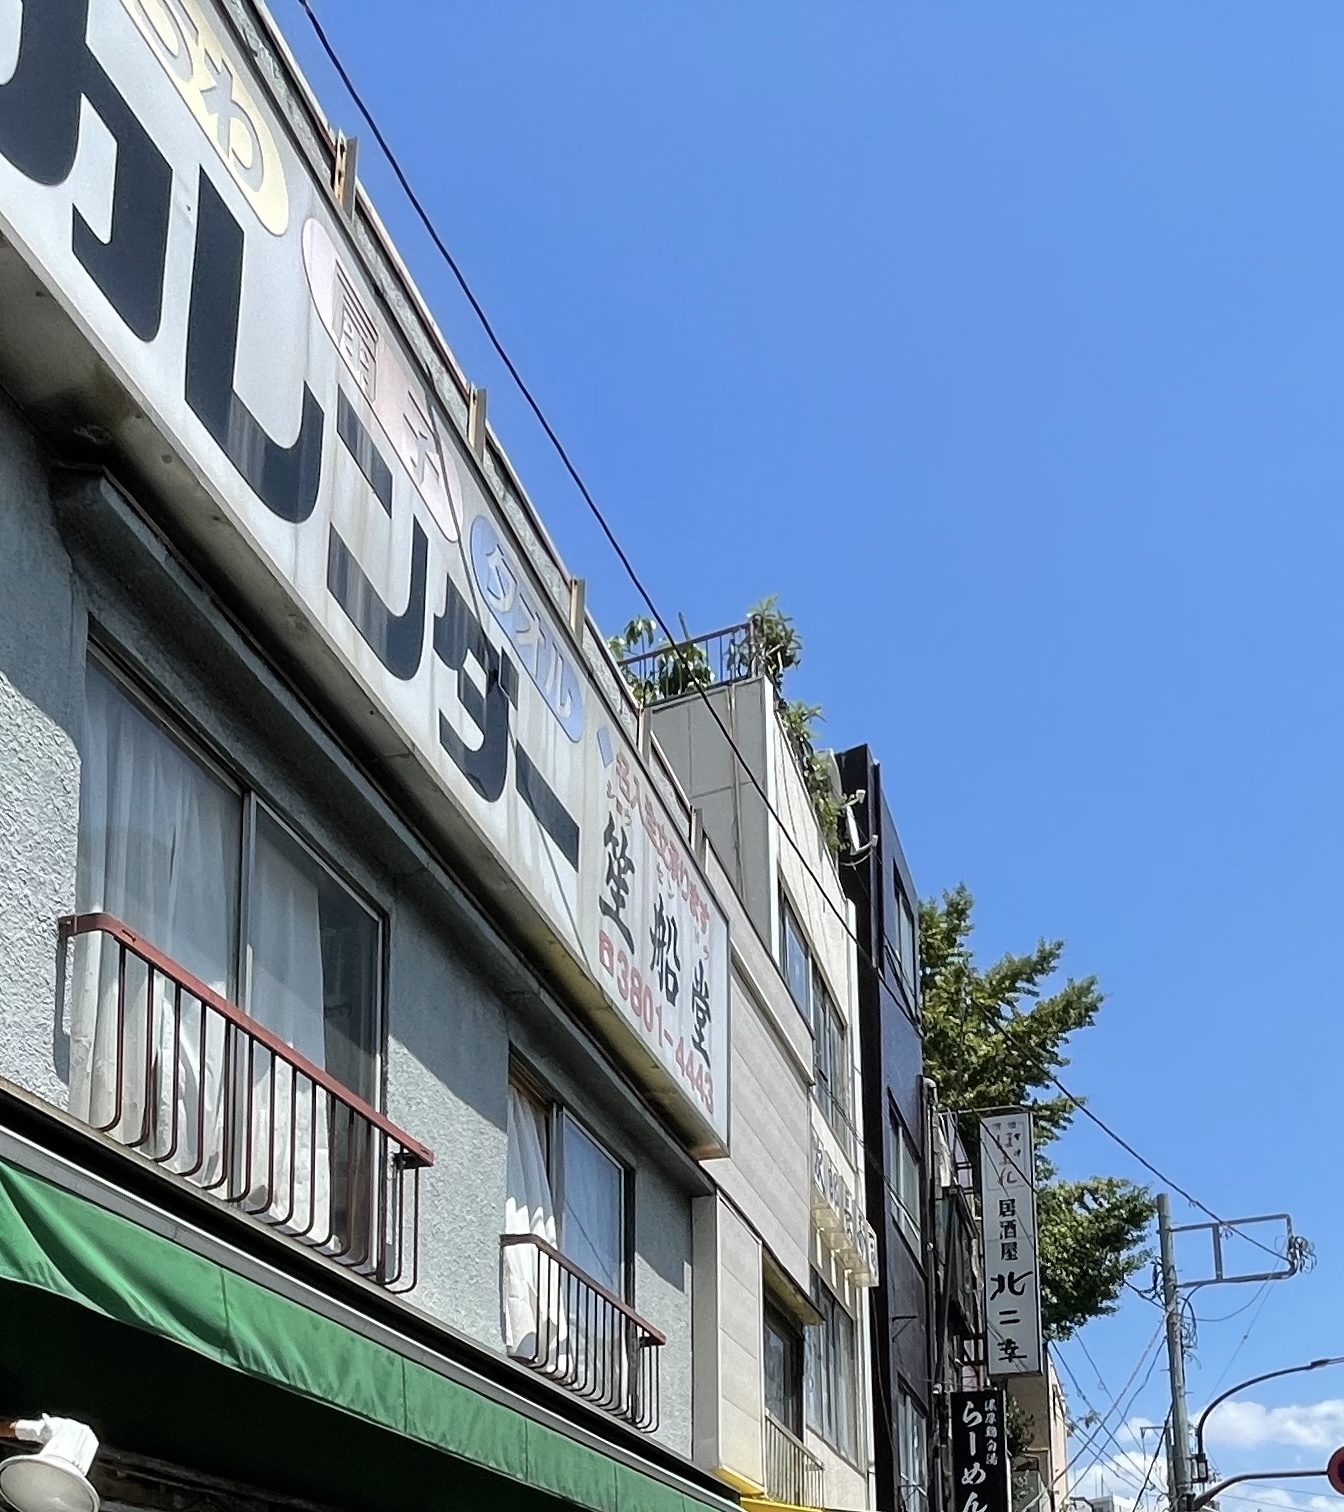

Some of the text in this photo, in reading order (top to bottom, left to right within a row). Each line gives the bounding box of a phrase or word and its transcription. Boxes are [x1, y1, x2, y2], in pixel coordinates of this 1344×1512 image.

[617, 949, 714, 1115] 3801-4443
[998, 1199, 1018, 1261] 居酒屋
